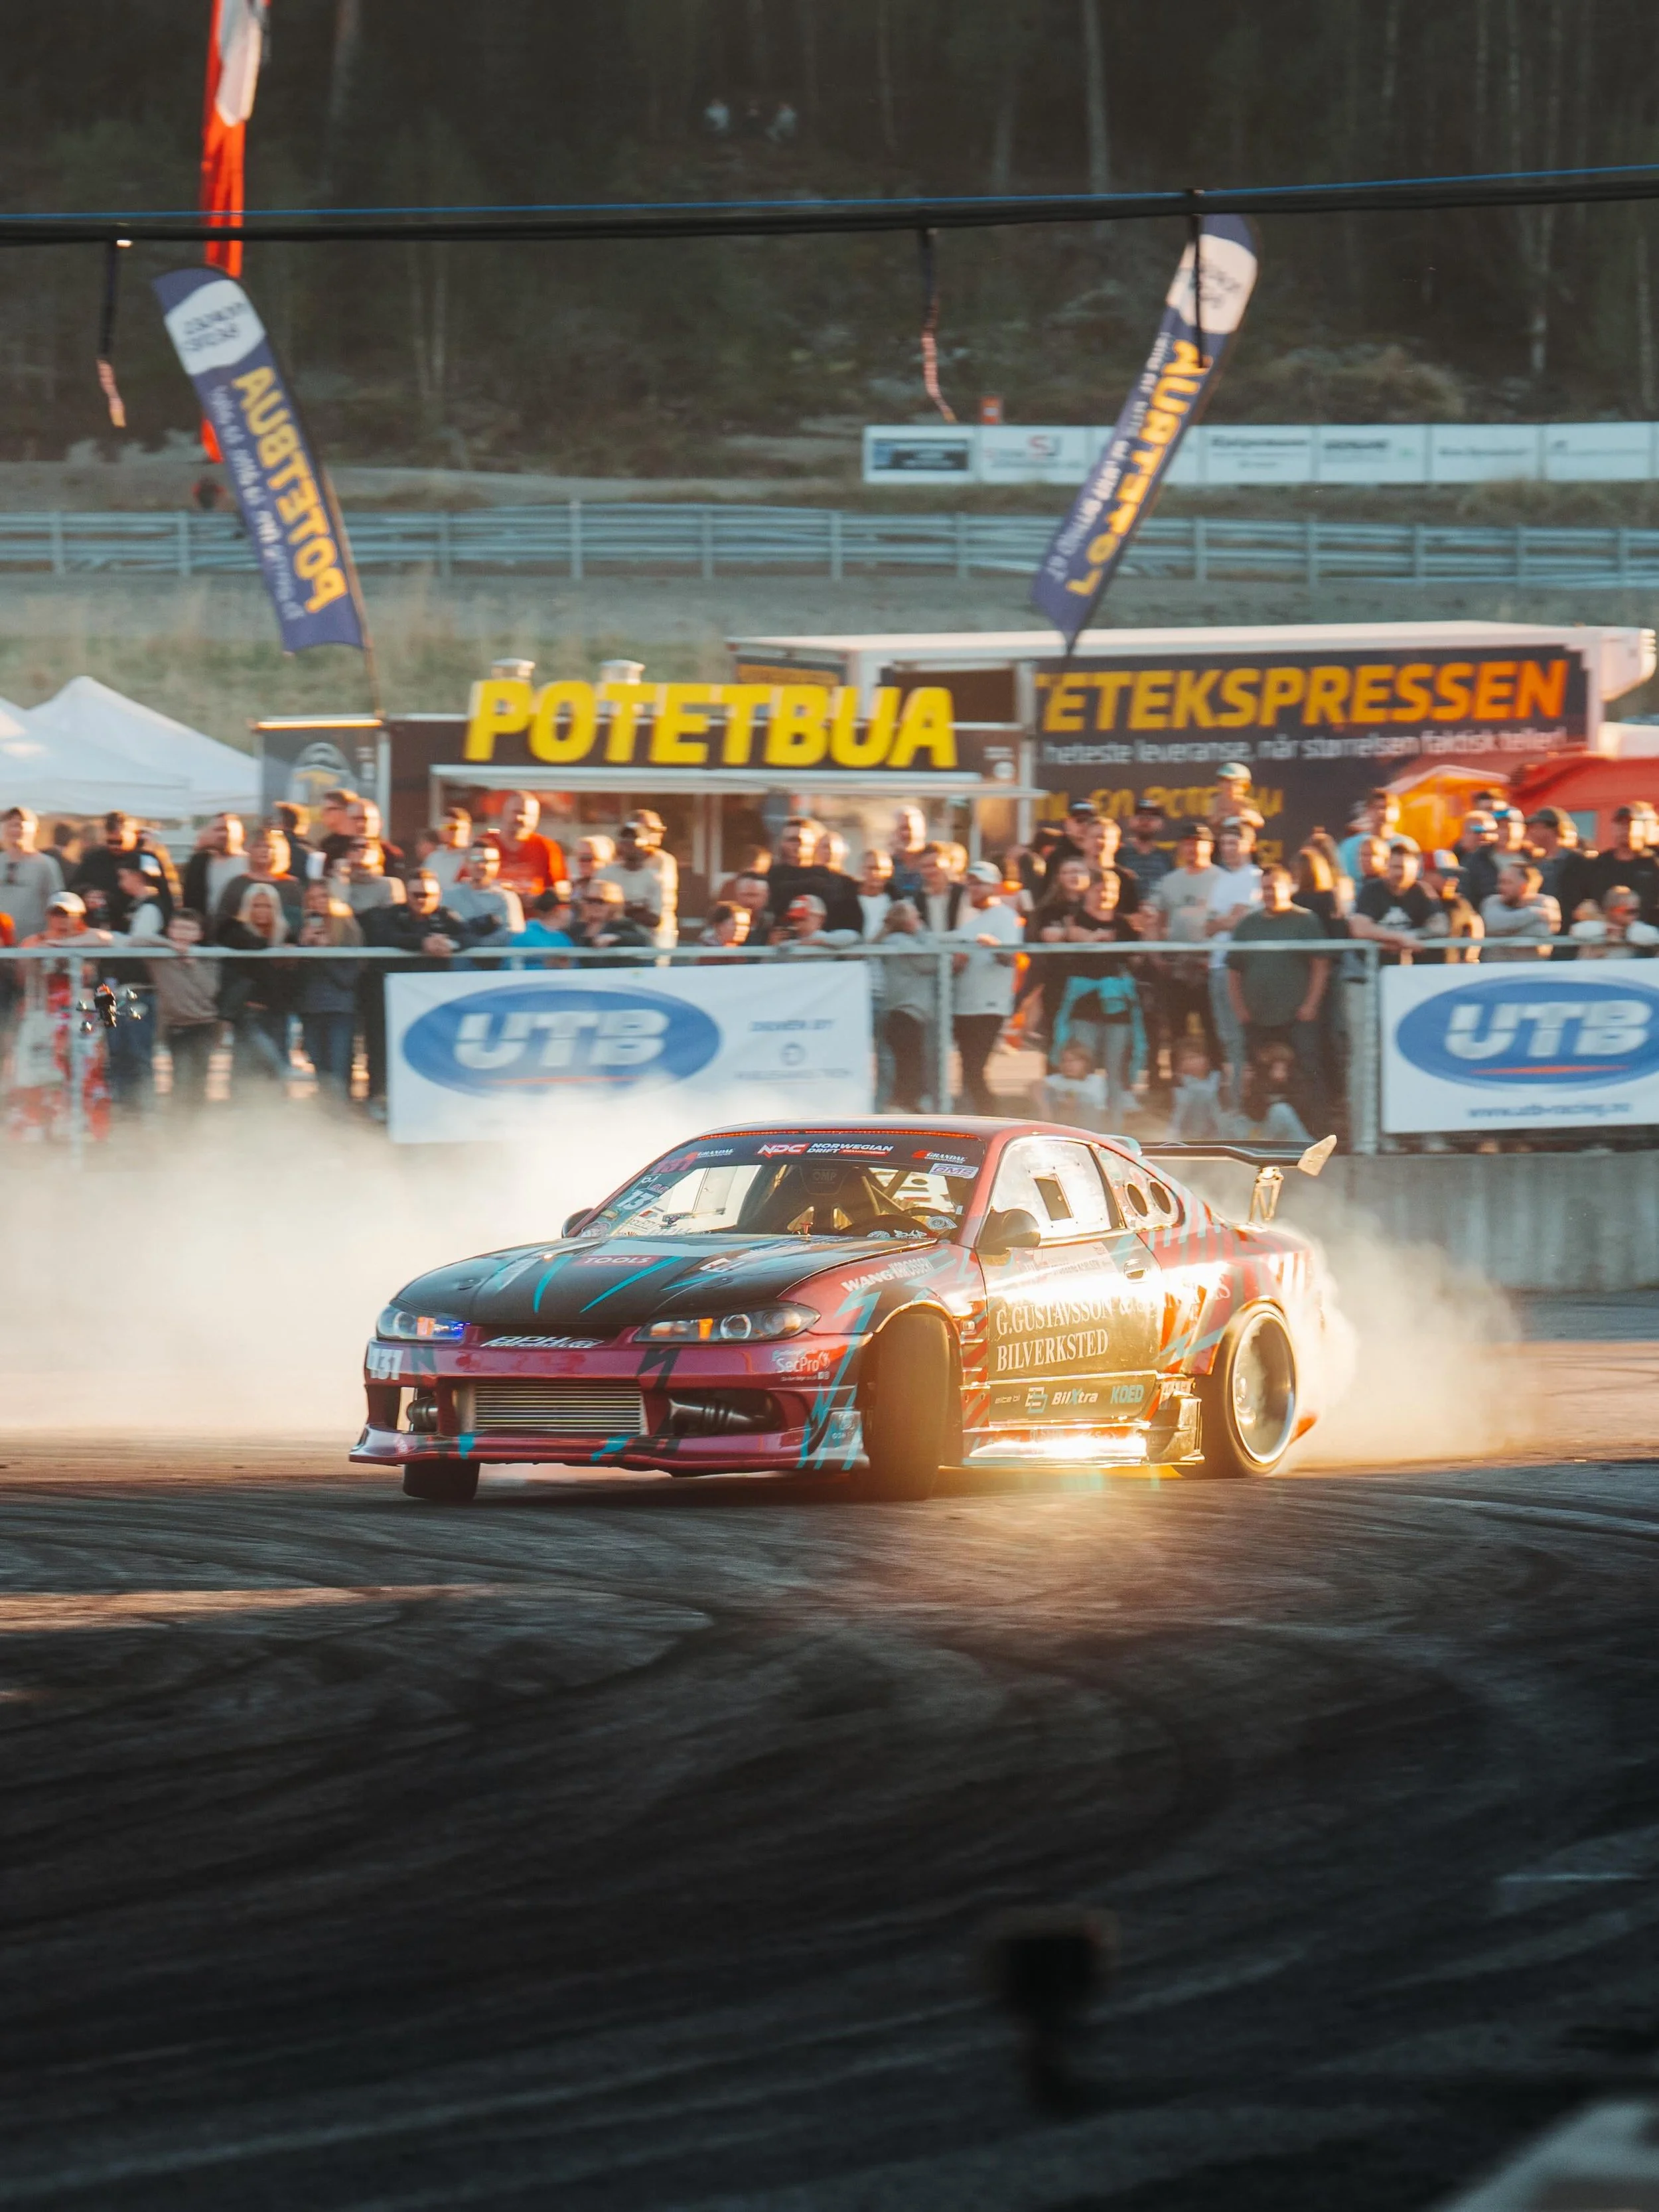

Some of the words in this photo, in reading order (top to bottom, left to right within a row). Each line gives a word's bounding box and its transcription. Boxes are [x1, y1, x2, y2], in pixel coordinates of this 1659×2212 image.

[1035, 660, 1569, 733] ETEKSPRESSEN
[465, 679, 958, 769] POTETBUA
[453, 1009, 670, 1069] UTB
[1445, 999, 1652, 1060] UTB
[757, 1143, 806, 1154] NDC
[811, 1143, 894, 1152] NORWEGIAN
[813, 1171, 837, 1181] OMP
[933, 1167, 974, 1175] GMS
[584, 1256, 653, 1265] TOOLS
[841, 1268, 895, 1292] WANG
[996, 1329, 1109, 1372] BILVERKSTED
[776, 1357, 819, 1372] SecPro
[1051, 1388, 1098, 1406] BilXtra
[1110, 1384, 1144, 1404] KOED
